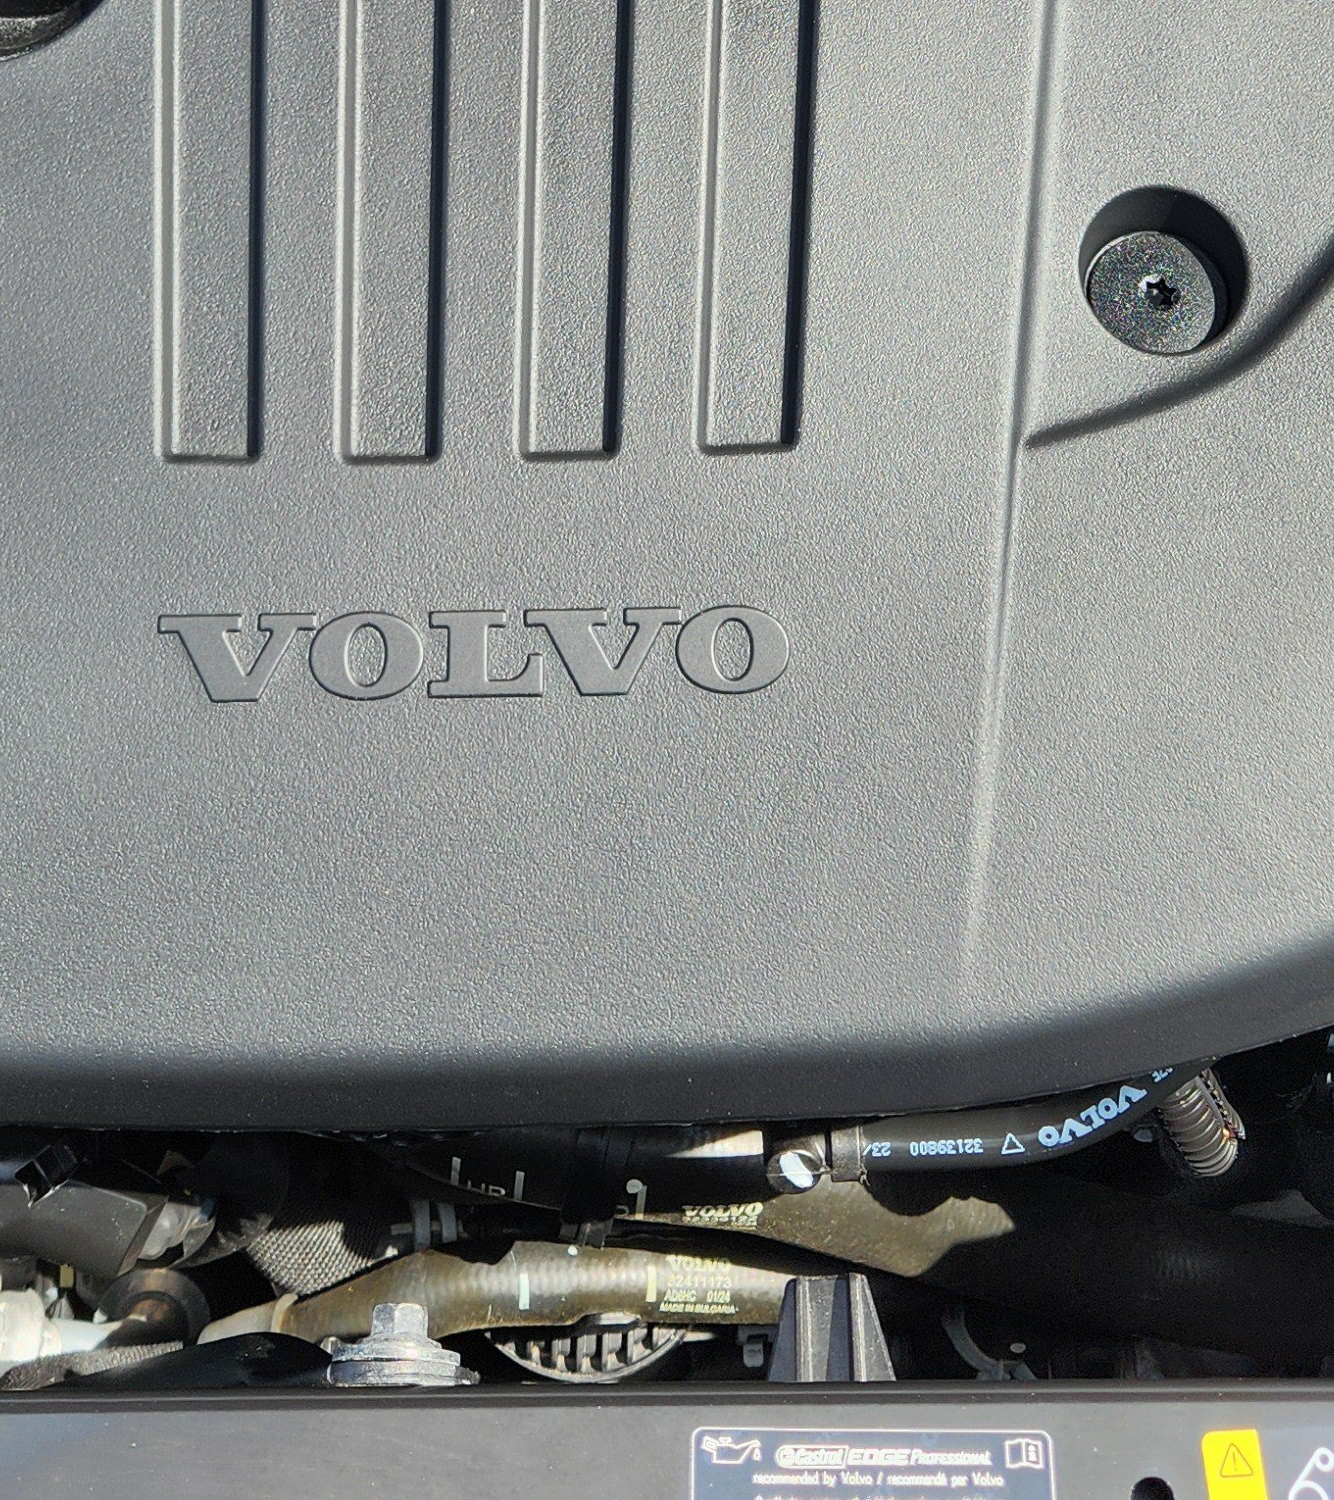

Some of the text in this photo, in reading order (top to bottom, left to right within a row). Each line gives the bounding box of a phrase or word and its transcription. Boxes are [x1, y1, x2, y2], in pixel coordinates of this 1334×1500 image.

[157, 604, 791, 703] VOLVO
[1038, 1085, 1148, 1147] VOLVO
[910, 1138, 984, 1157] 32139800
[682, 1202, 764, 1218] VOLVO
[667, 1274, 733, 1289] 32411173
[684, 1303, 695, 1313] IN
[791, 1447, 845, 1467] Castrol
[848, 1449, 910, 1466] EDGE
[752, 1471, 819, 1485] recommended
[823, 1472, 837, 1488] by
[842, 1471, 874, 1485] Volvo
[971, 1471, 1005, 1486] Volvo
